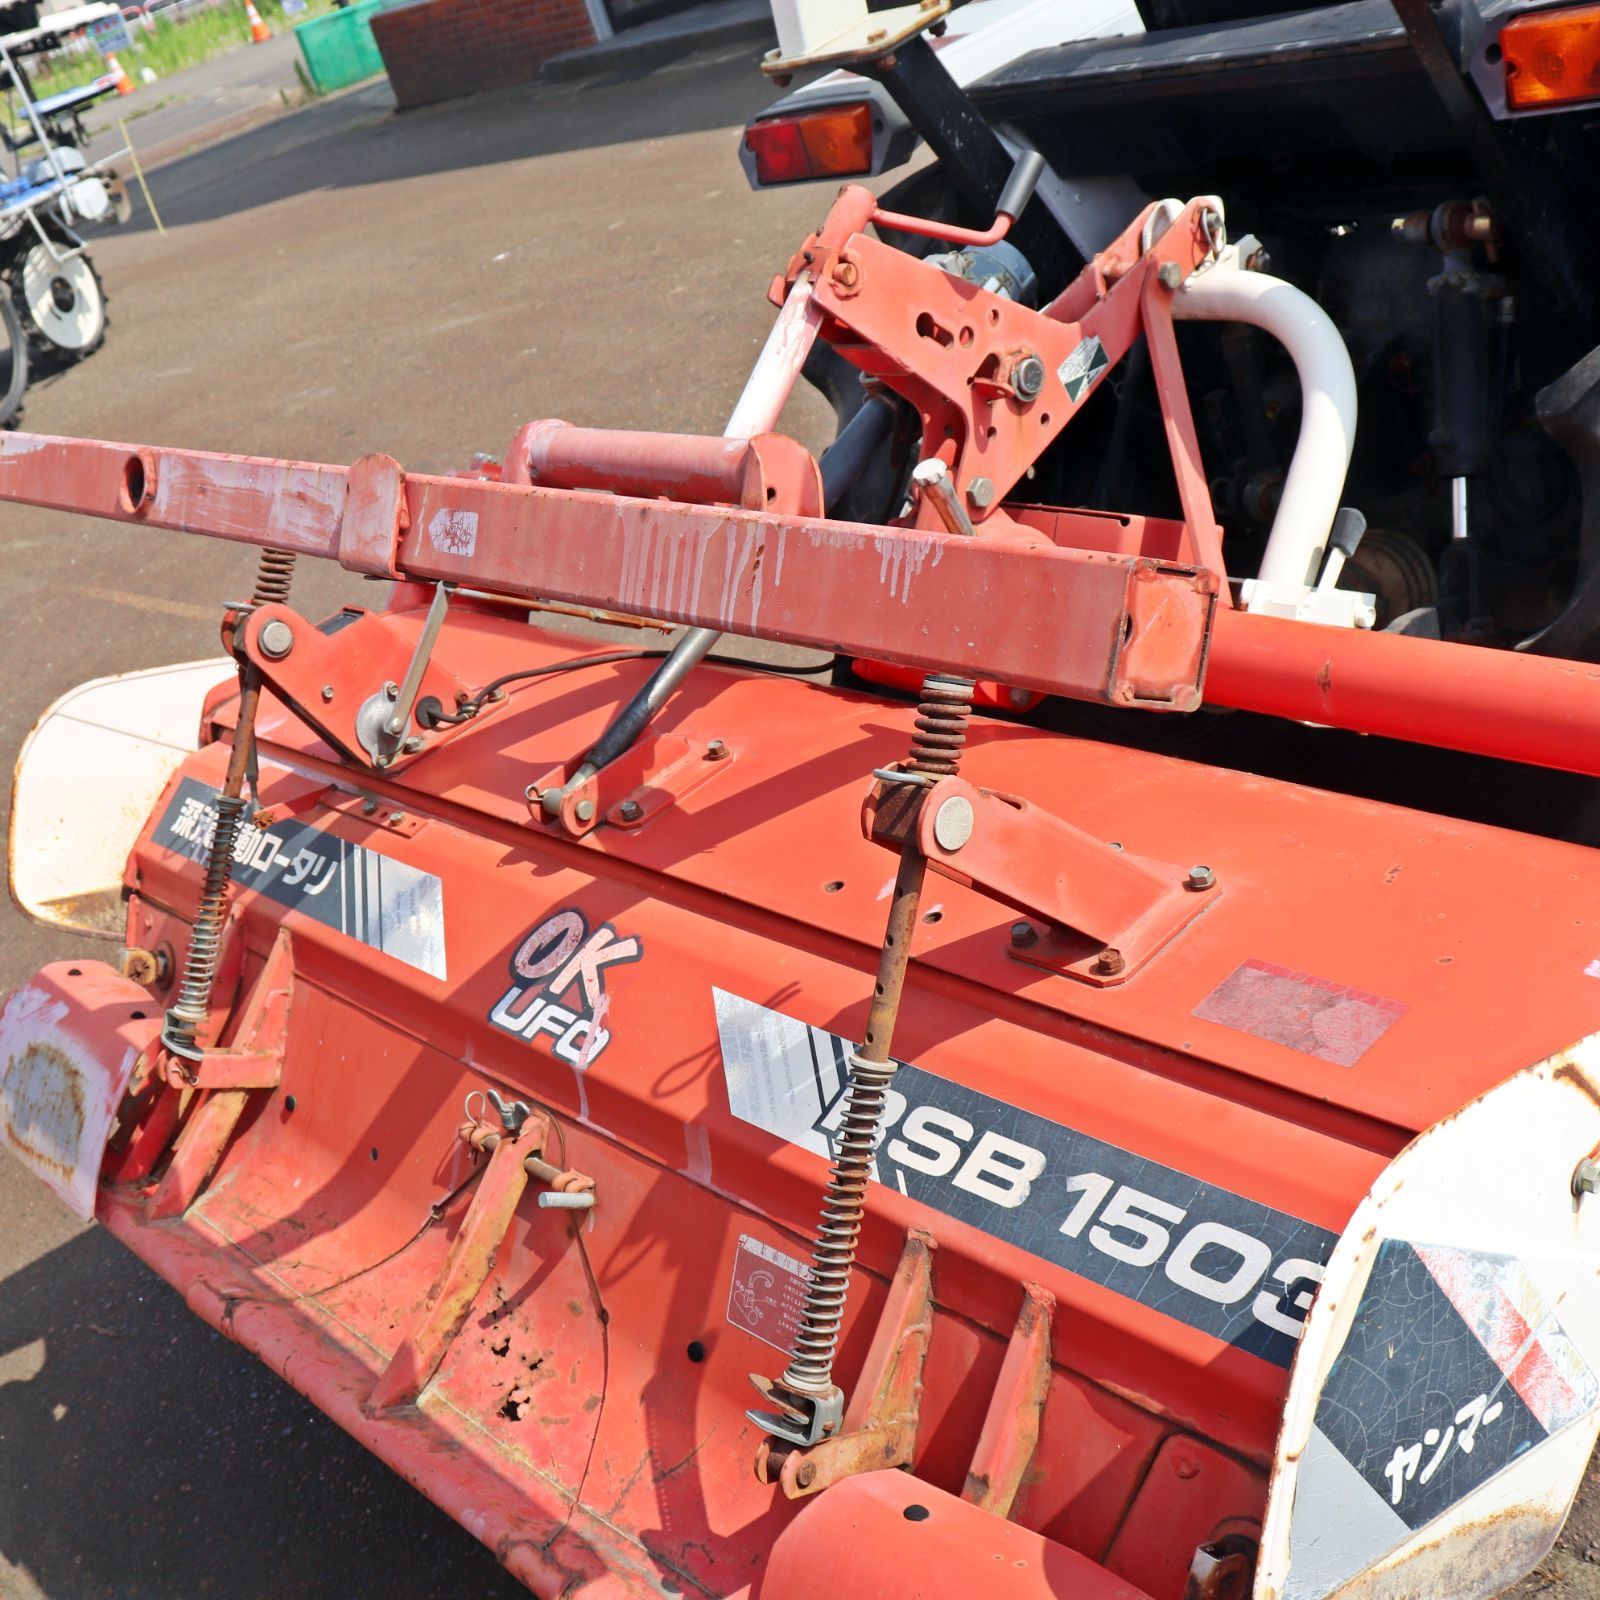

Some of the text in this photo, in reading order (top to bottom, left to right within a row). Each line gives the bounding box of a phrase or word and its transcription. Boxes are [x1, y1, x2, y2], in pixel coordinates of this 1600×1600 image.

[513, 911, 639, 1009] OK
[490, 986, 610, 1065] UFO
[1384, 1394, 1503, 1505] ヤンマー
